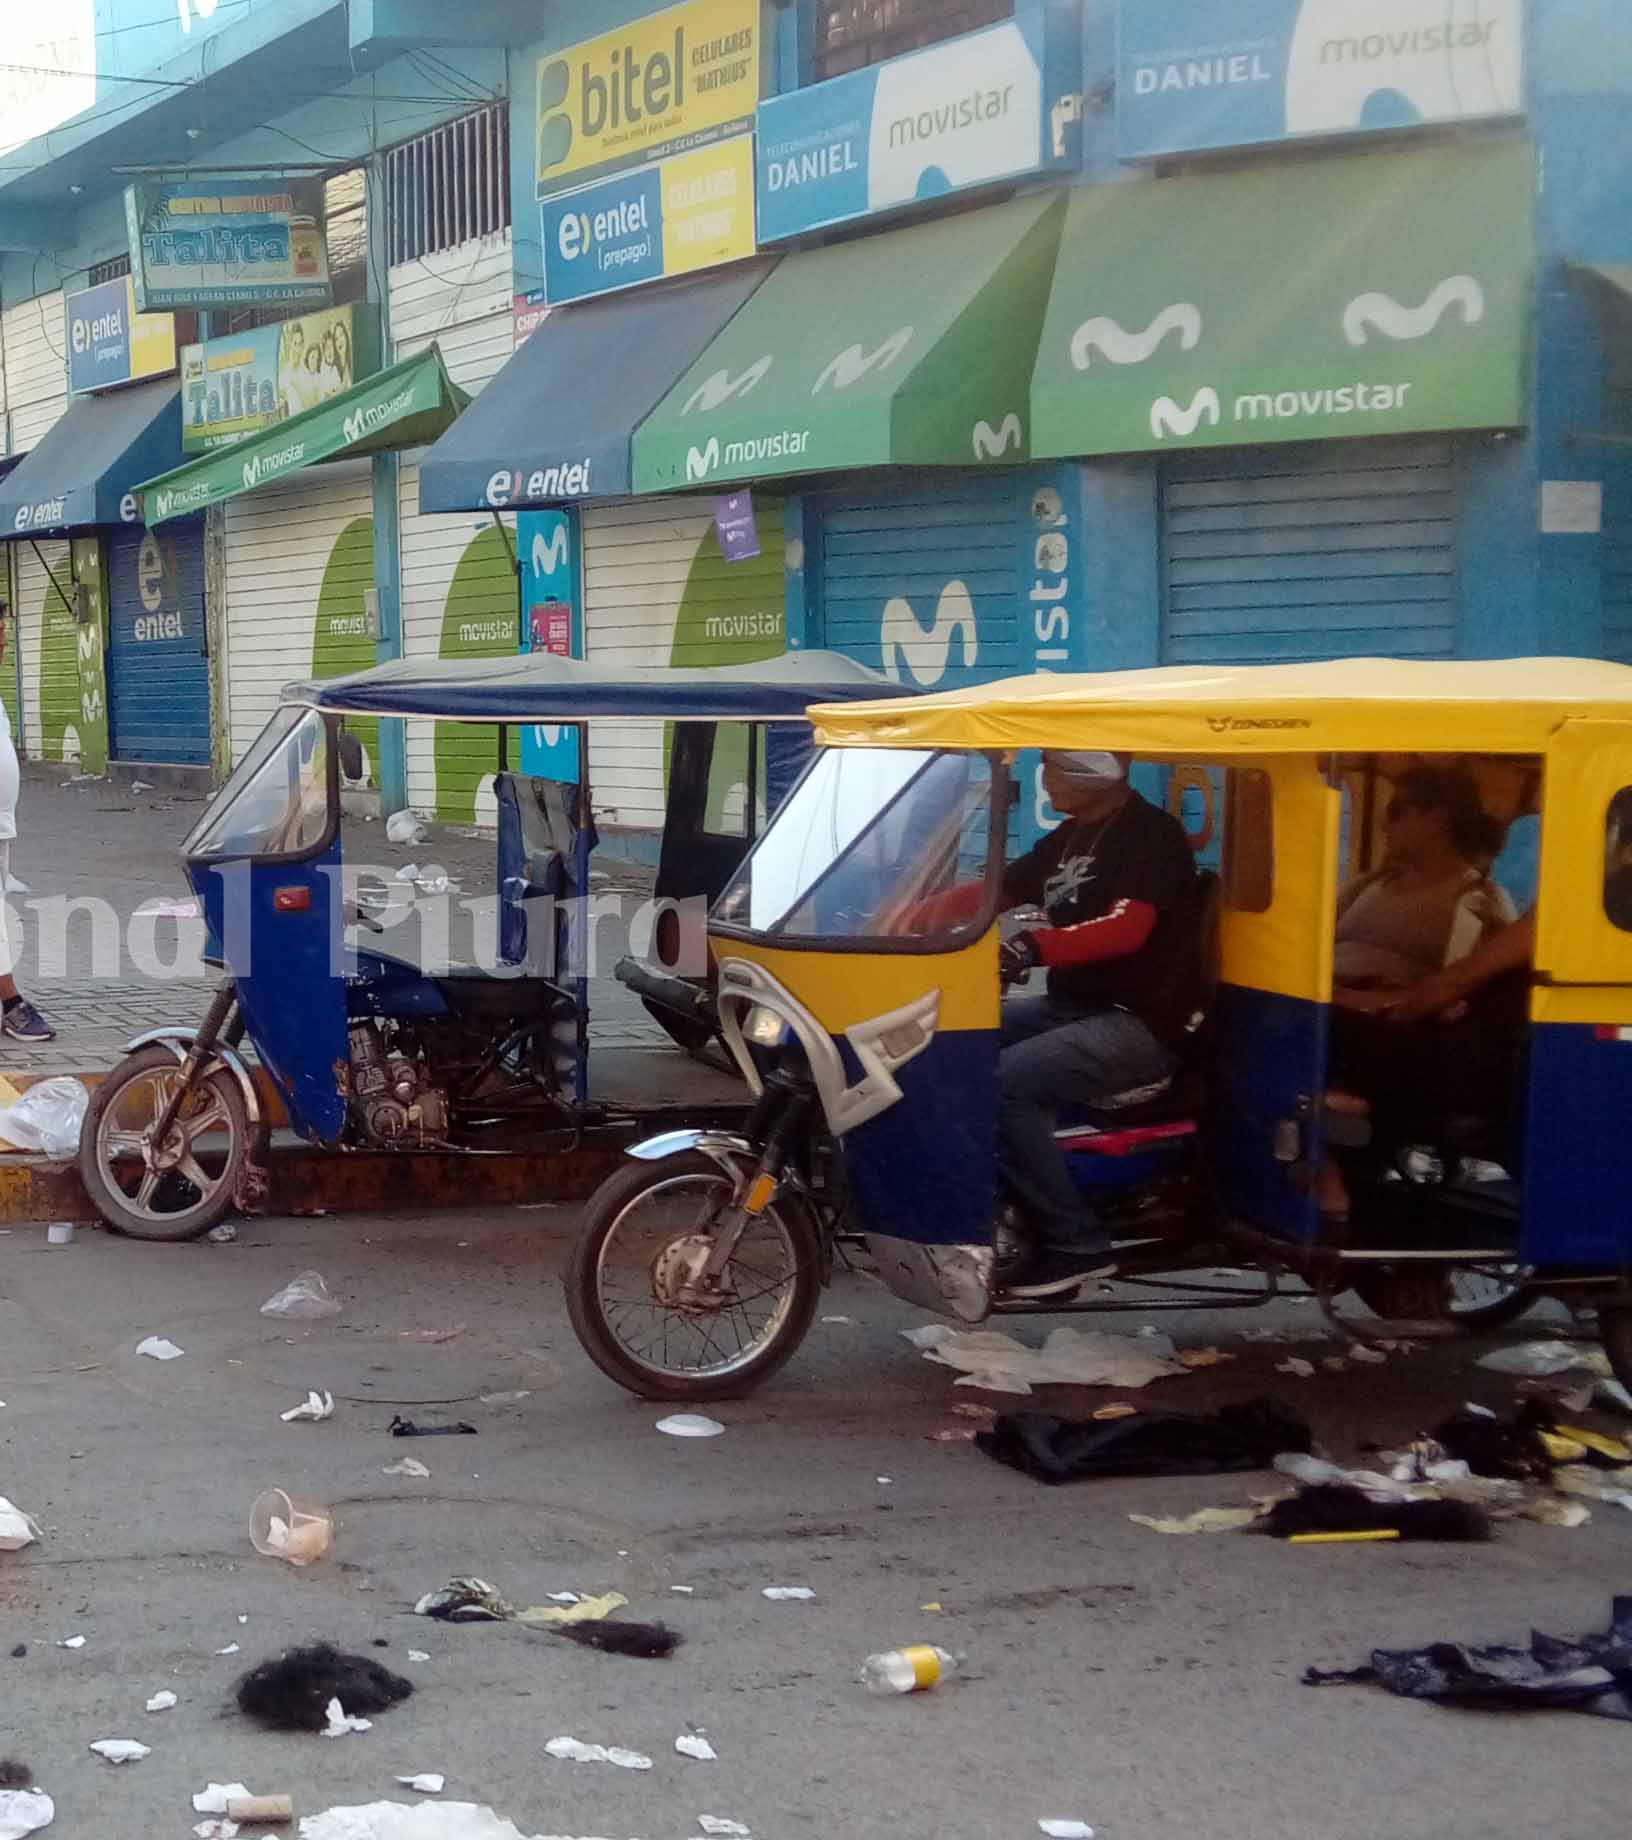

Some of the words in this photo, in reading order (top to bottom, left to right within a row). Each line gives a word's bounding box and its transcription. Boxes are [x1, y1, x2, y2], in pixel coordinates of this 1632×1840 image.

[1319, 17, 1498, 65] movistar
[581, 26, 685, 137] bitel
[1134, 54, 1272, 95] DANIEL
[889, 84, 1014, 148] movistar
[767, 141, 858, 192] DANIEL
[594, 194, 648, 241] entel
[143, 226, 288, 267] Talita
[92, 309, 123, 340] entel
[189, 370, 276, 427] Talita
[1234, 382, 1412, 421] movistar
[261, 442, 305, 474] movistar
[723, 430, 810, 466] movistar
[527, 458, 590, 499] entel
[134, 611, 184, 641] entel
[459, 620, 514, 641] movistar
[705, 612, 784, 637] movistar
